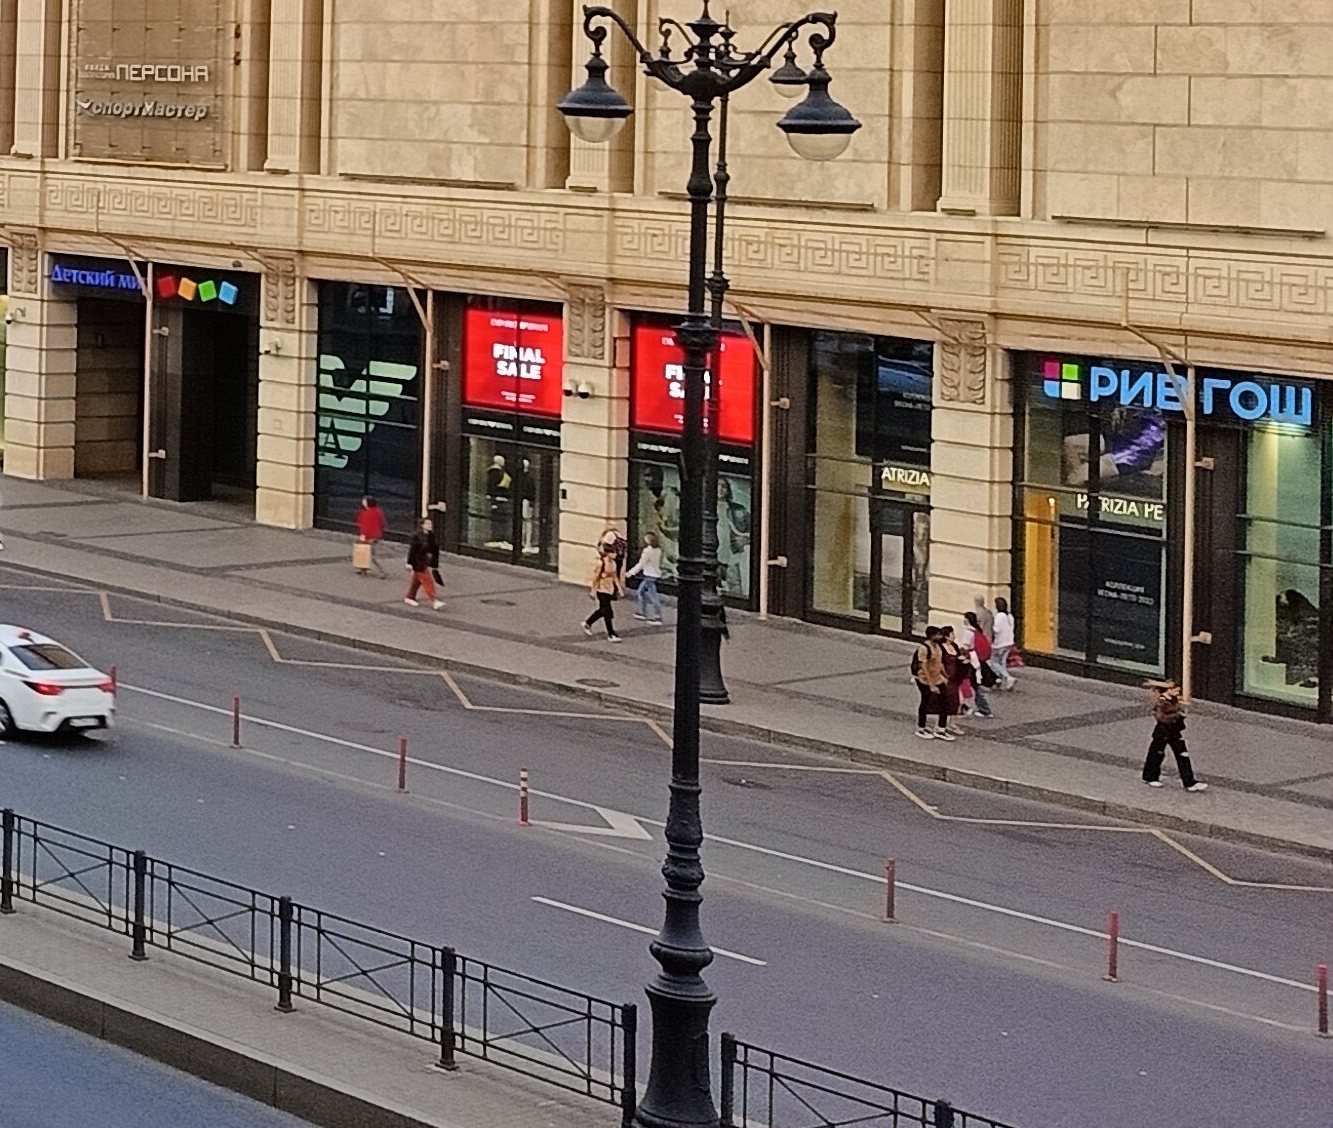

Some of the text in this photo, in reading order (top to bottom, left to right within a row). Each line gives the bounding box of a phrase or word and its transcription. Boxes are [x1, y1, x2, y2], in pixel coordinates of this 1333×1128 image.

[116, 64, 209, 82] ПЕРСОНА
[51, 264, 115, 287] Детский
[493, 343, 546, 364] FINAL
[496, 360, 541, 380] SALE
[1090, 366, 1312, 426] РИВ ГОШ
[1077, 493, 1140, 517] PRIZIA
